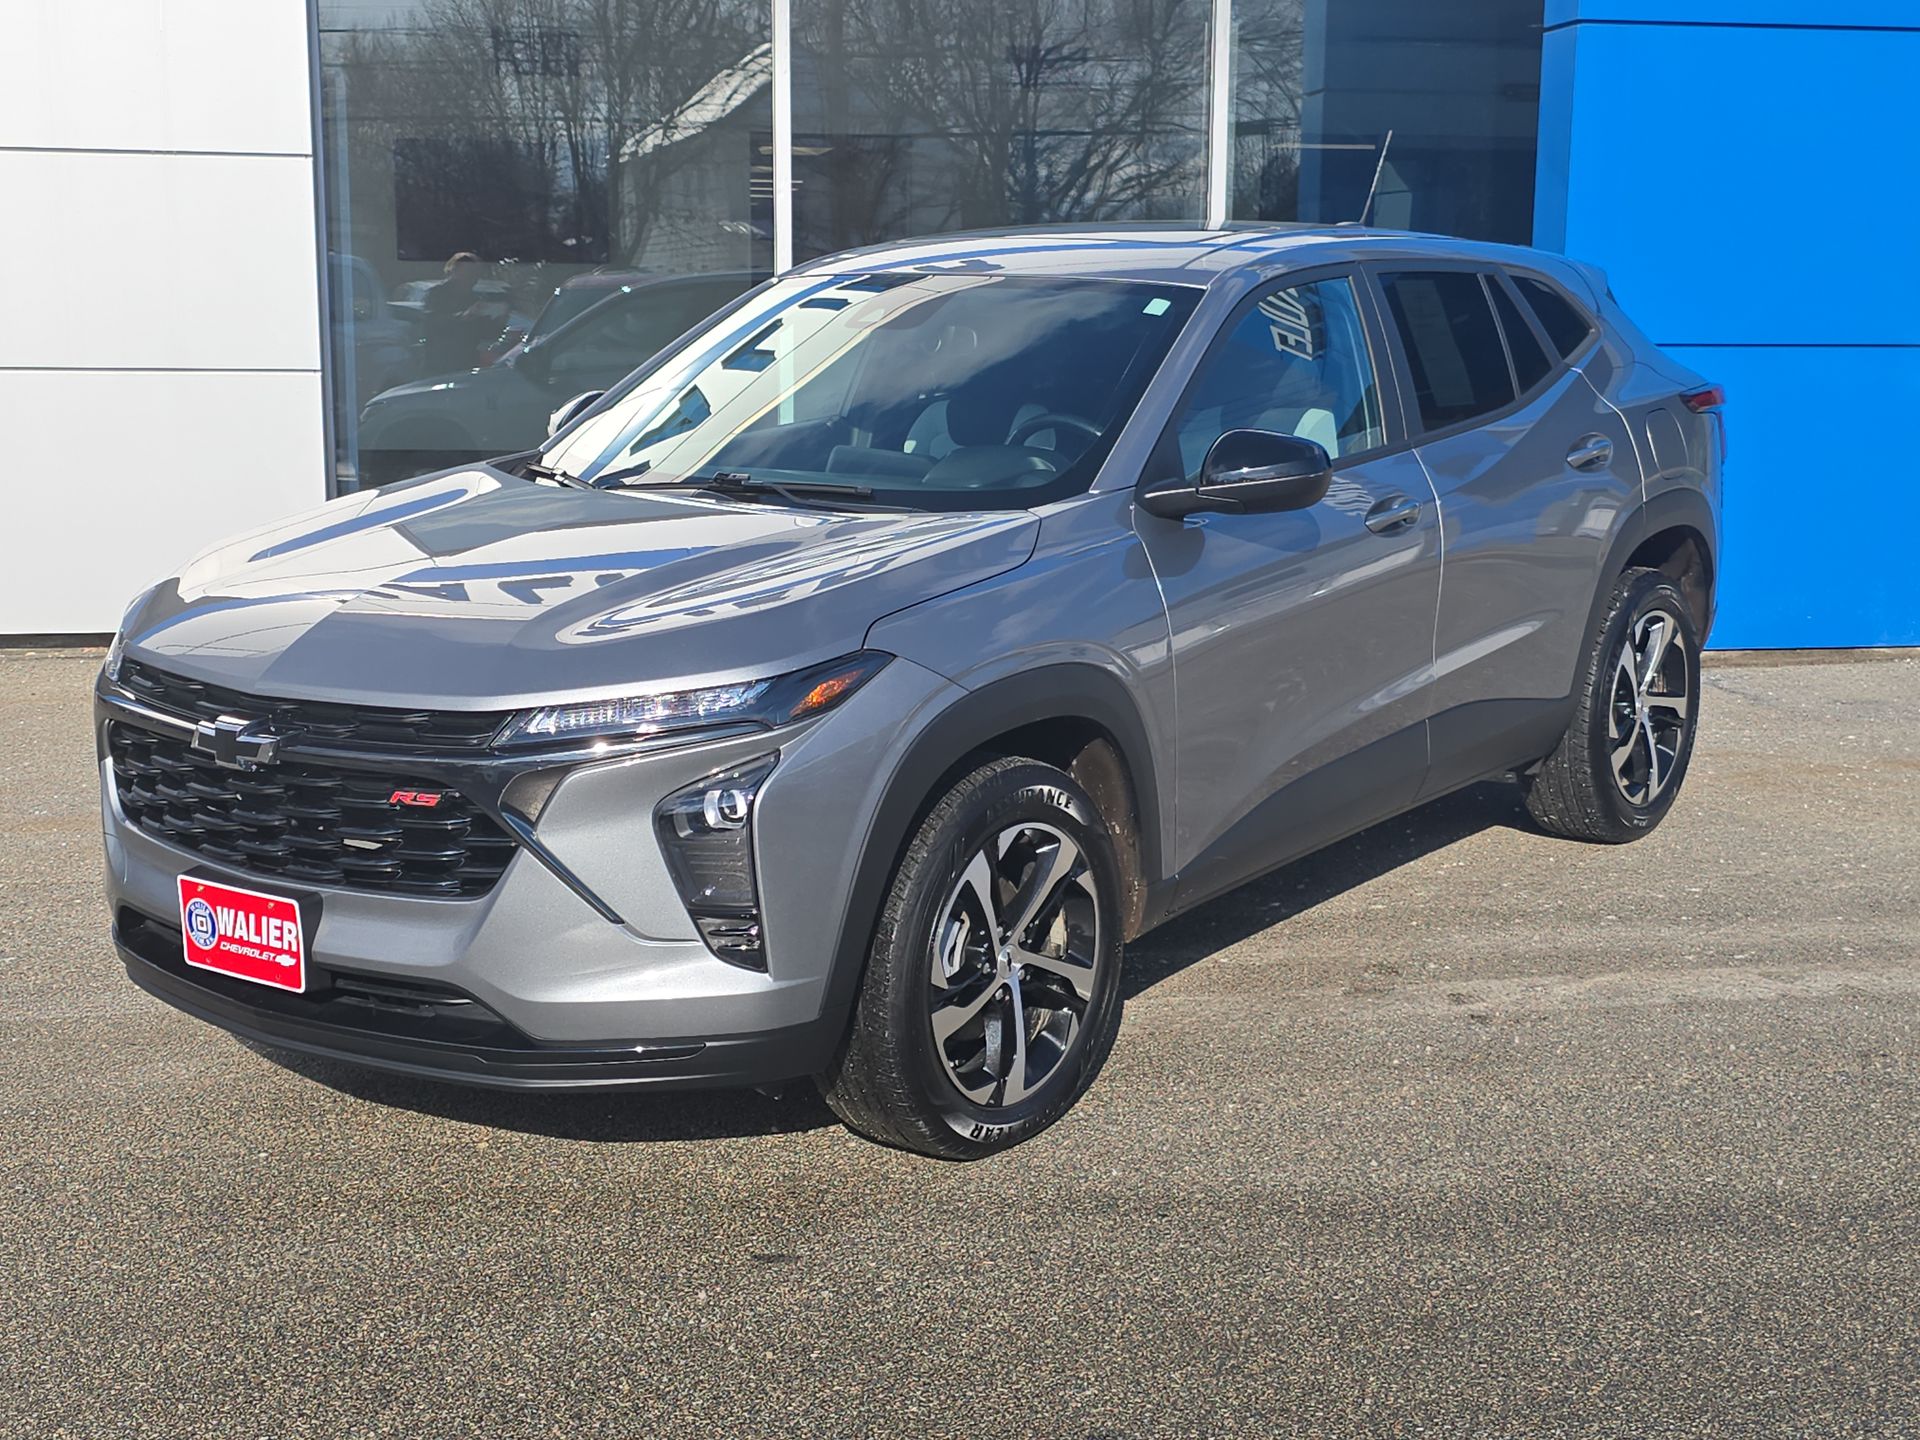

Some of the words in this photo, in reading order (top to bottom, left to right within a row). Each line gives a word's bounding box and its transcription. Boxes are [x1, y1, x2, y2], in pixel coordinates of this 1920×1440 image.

[389, 791, 441, 807] RS
[216, 905, 298, 952] WALIER
[219, 941, 276, 962] CHEVROLET
